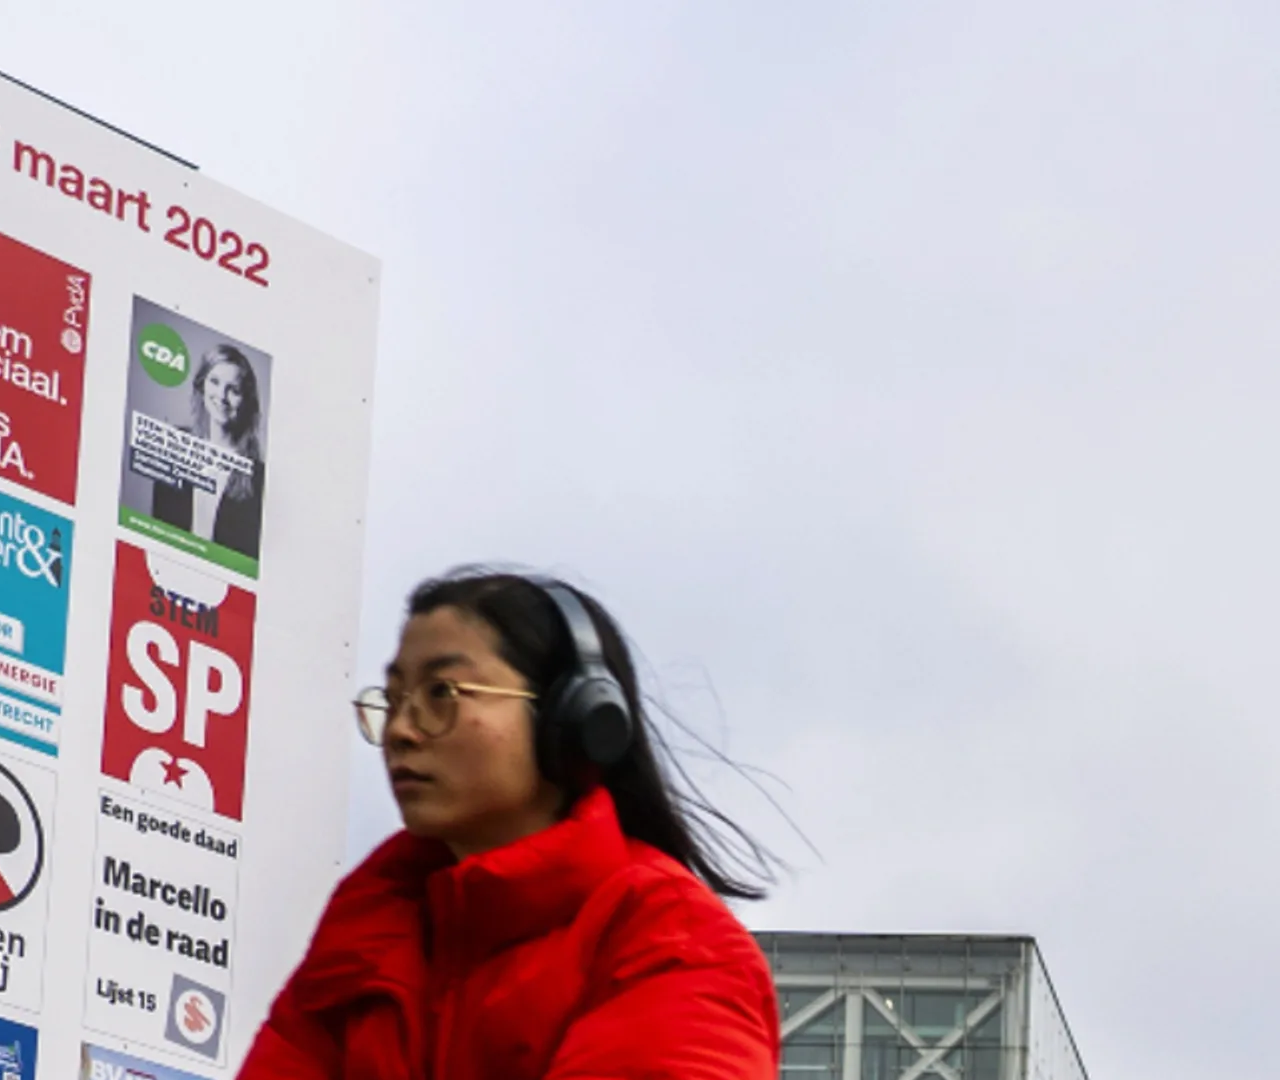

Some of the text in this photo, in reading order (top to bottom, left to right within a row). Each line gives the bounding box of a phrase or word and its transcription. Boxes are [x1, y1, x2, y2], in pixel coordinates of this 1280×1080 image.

[14, 140, 151, 231] maart
[164, 205, 270, 287] 2022
[141, 341, 186, 372] CDA
[150, 585, 218, 638] STEM
[122, 620, 242, 748] SP
[101, 795, 237, 859] Een goede daad
[104, 855, 226, 922] Marcello
[95, 897, 228, 969] in de raad
[97, 977, 156, 1013] Lijst 15
